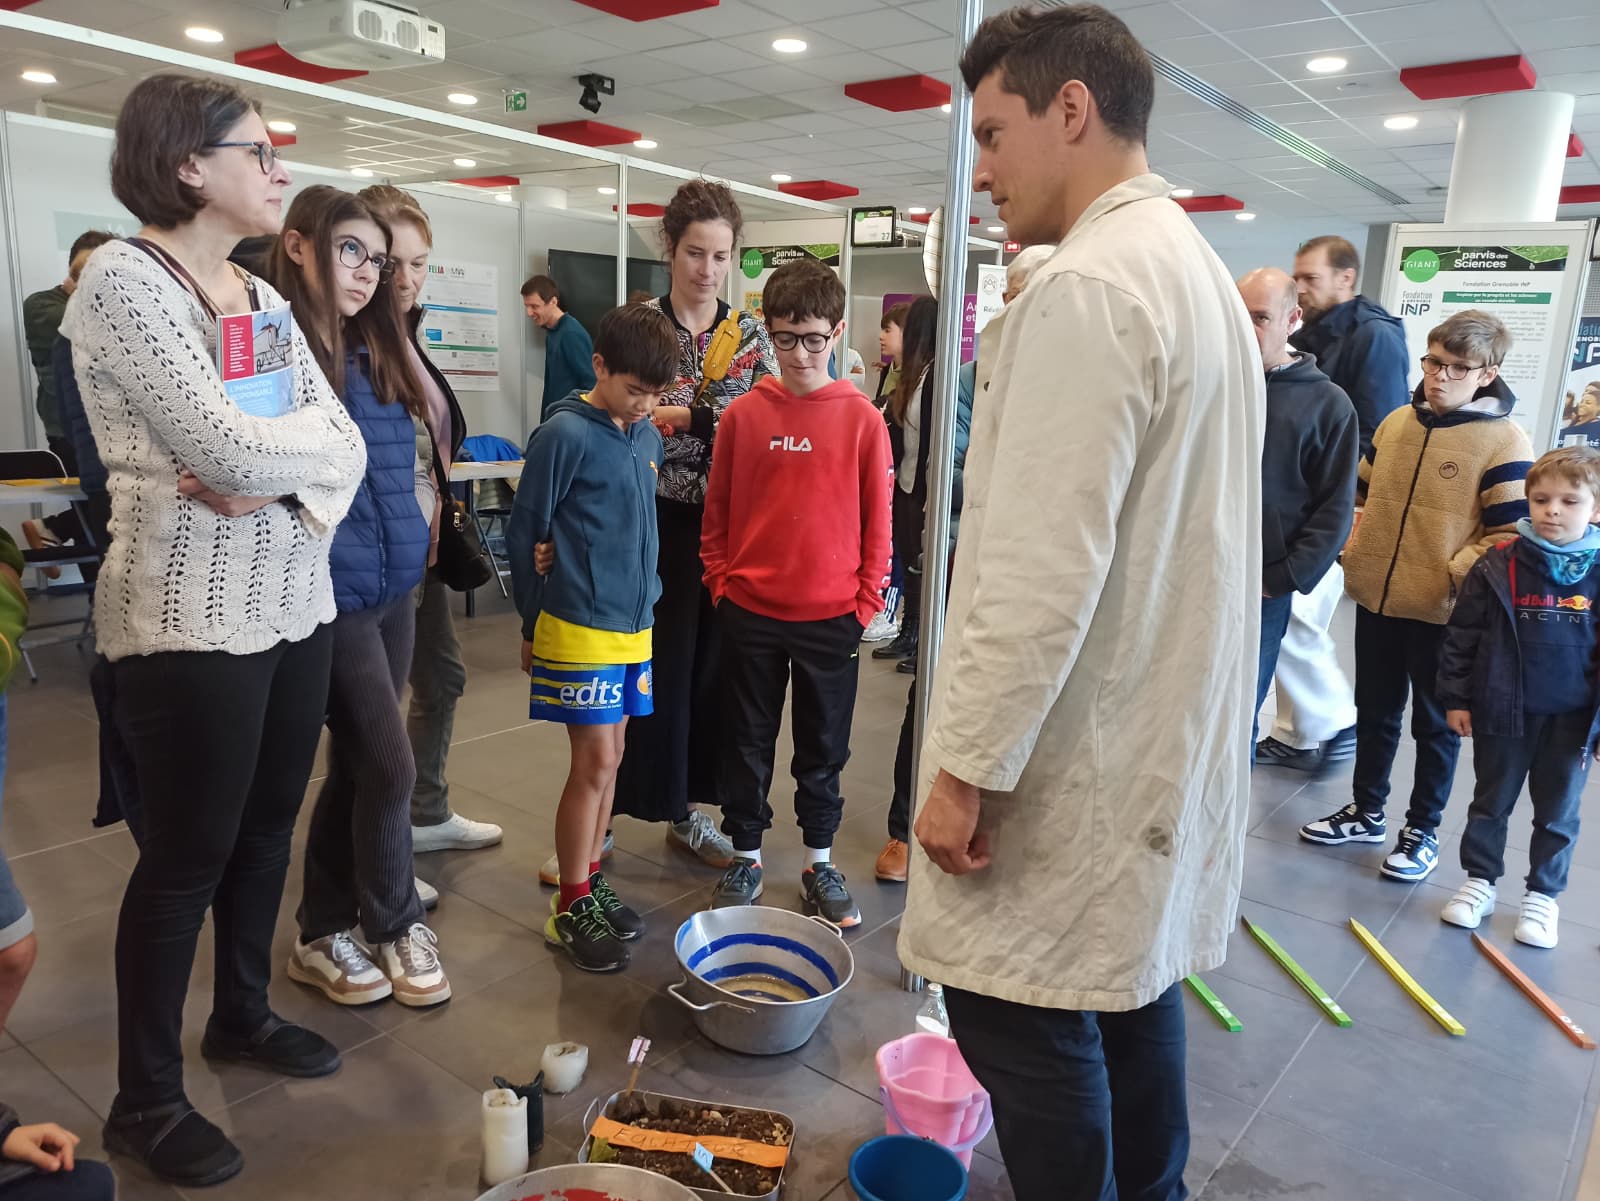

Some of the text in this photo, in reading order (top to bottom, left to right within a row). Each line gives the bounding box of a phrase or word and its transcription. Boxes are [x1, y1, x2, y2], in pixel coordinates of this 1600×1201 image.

[775, 248, 797, 258] parvis
[1461, 250, 1496, 260] parvis
[1405, 261, 1439, 269] GIANT
[1453, 258, 1508, 269] Sciences
[1400, 303, 1431, 316] INP
[769, 436, 813, 452] FILA
[1532, 594, 1554, 606] Bull
[560, 677, 623, 706] edts
